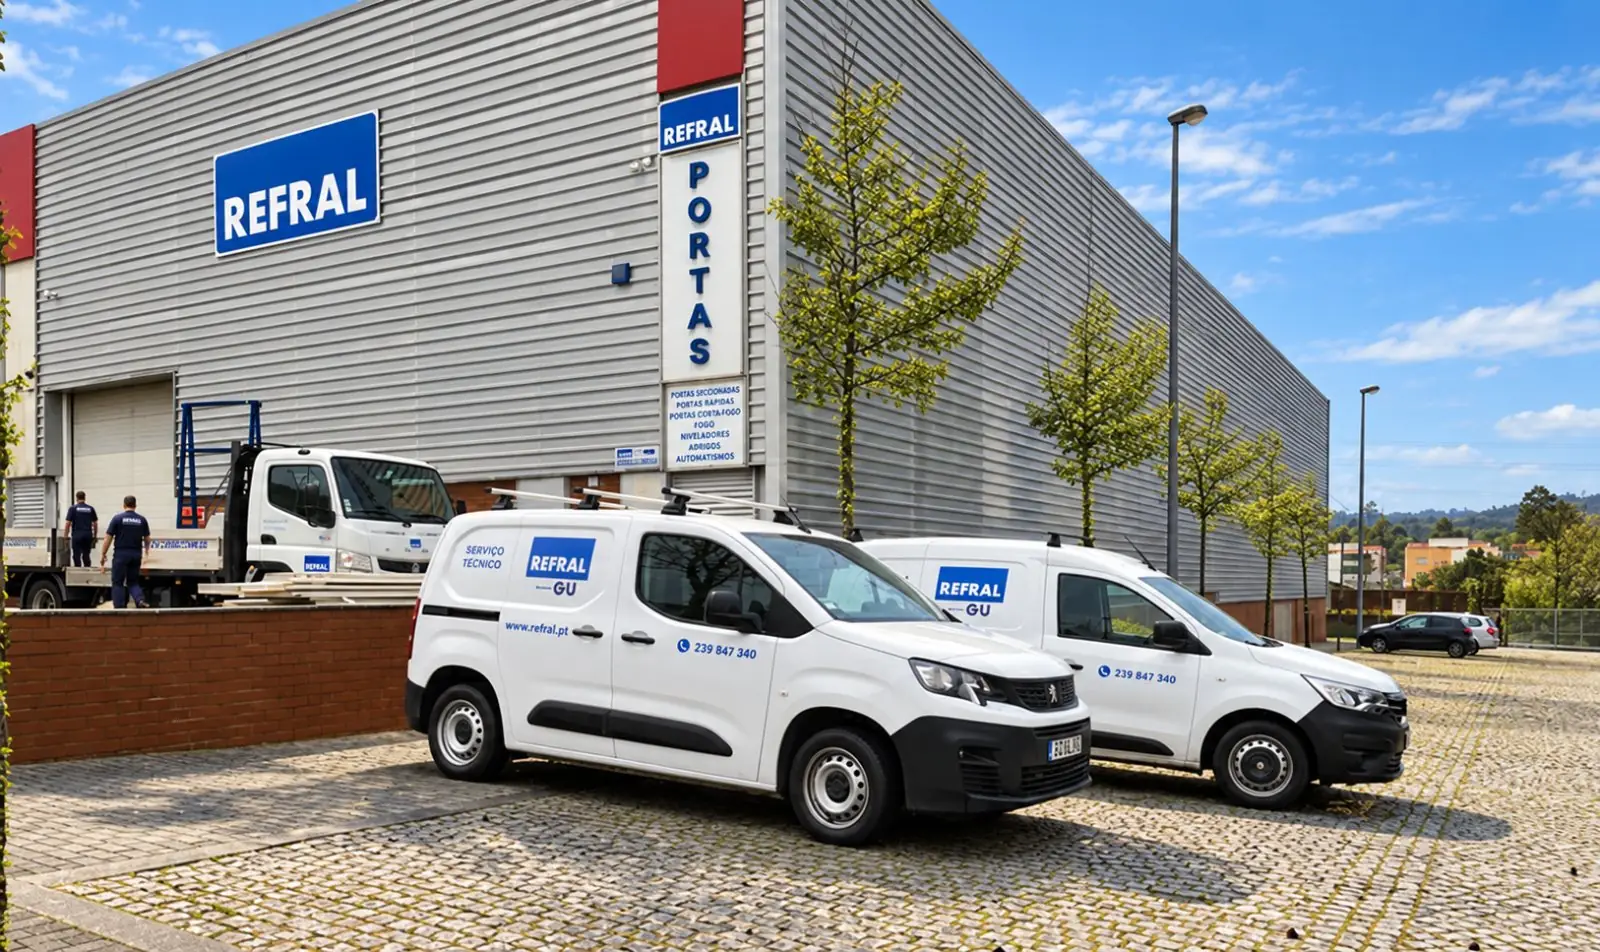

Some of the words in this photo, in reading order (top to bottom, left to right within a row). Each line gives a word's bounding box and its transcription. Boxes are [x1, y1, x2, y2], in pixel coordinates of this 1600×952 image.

[663, 113, 734, 146] REFRAL
[224, 167, 367, 241] REFRAL
[687, 161, 713, 366] PORTAS
[676, 401, 703, 409] PORTAS
[680, 430, 730, 440] NIVELADORES
[676, 452, 735, 462] AUTOMATISMOS
[465, 545, 505, 557] SERVIÇO
[462, 558, 502, 569] TÉCNICO
[530, 555, 587, 573] REFRAL
[553, 581, 577, 596] GU
[940, 581, 1001, 597] REFRAL
[966, 603, 991, 617] GU
[505, 622, 569, 637] www.refral.pt
[694, 642, 713, 654] 239
[715, 645, 735, 656] 847
[737, 648, 757, 659] 340
[1114, 669, 1133, 679] 239
[1135, 671, 1154, 681] 847
[1157, 673, 1177, 684] 340
